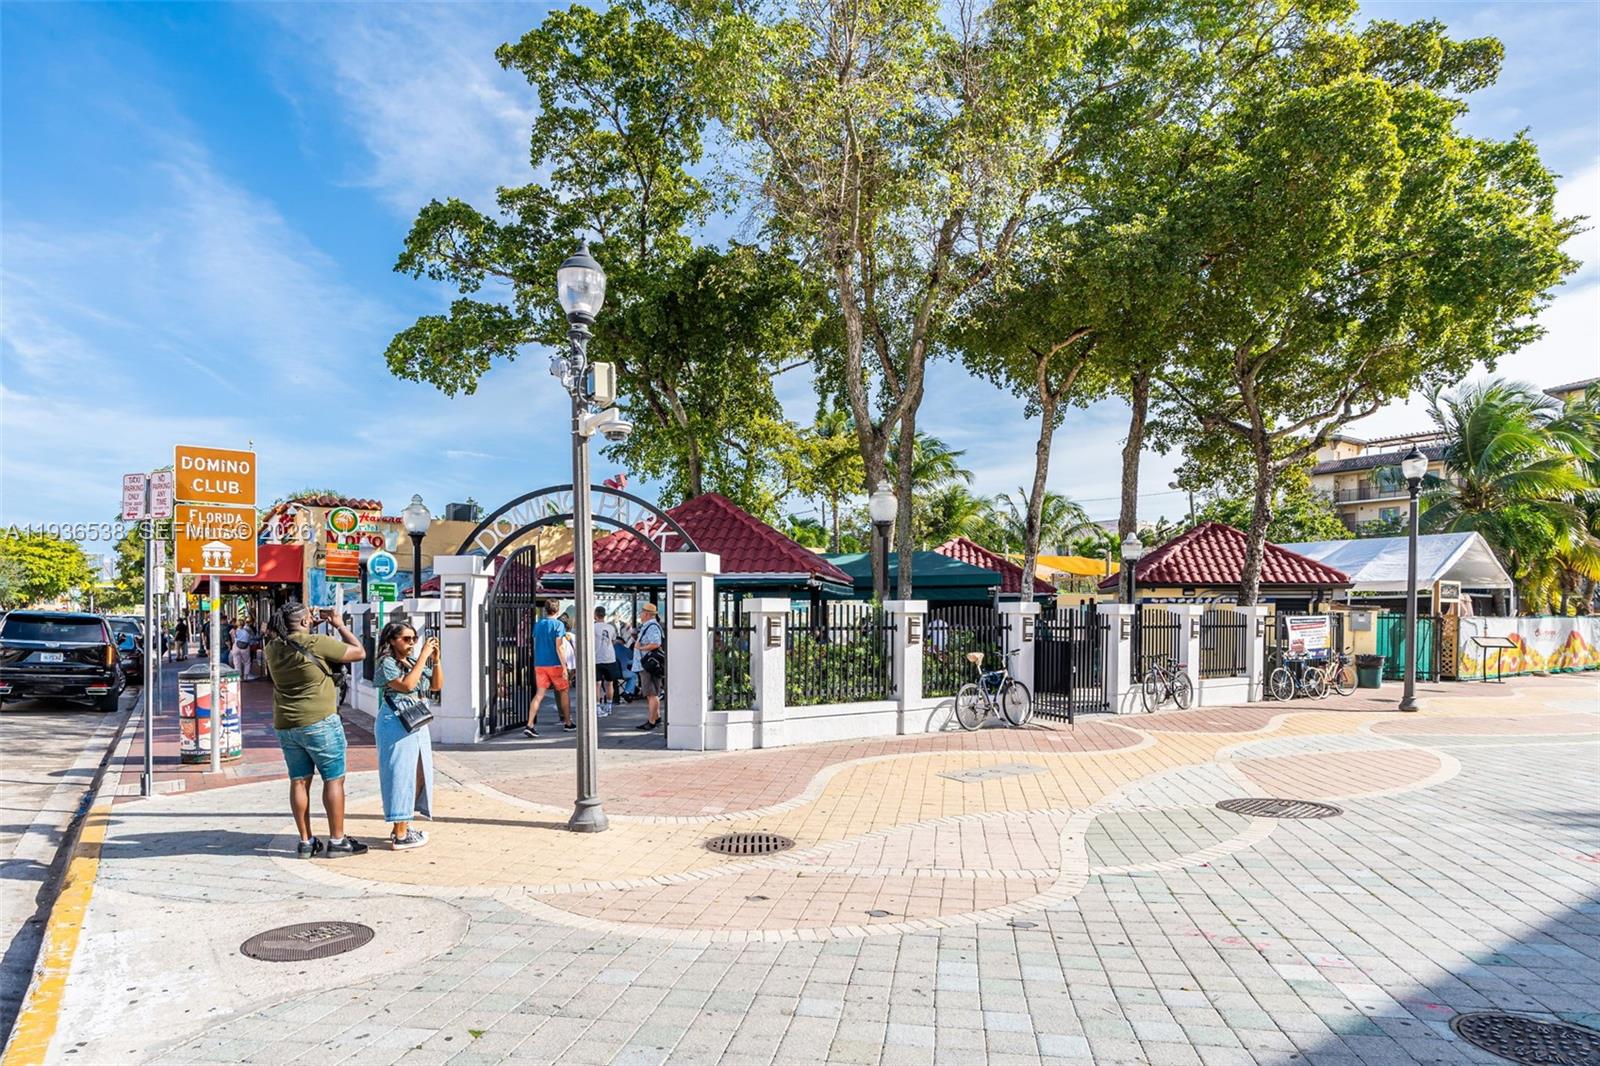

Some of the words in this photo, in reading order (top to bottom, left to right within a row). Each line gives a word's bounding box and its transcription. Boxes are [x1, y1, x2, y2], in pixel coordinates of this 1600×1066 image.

[181, 455, 250, 475] DOMINO
[158, 474, 166, 482] NO
[124, 484, 144, 492] PARKING
[152, 482, 171, 490] PARKING
[192, 478, 240, 495] CLUB
[127, 493, 140, 501] ONLY
[157, 490, 166, 498] ANY
[156, 497, 168, 505] TIME
[189, 509, 243, 524] FLORIDA
[359, 512, 402, 523] Havana
[599, 492, 679, 552] PARK
[326, 530, 384, 547] Mojto
